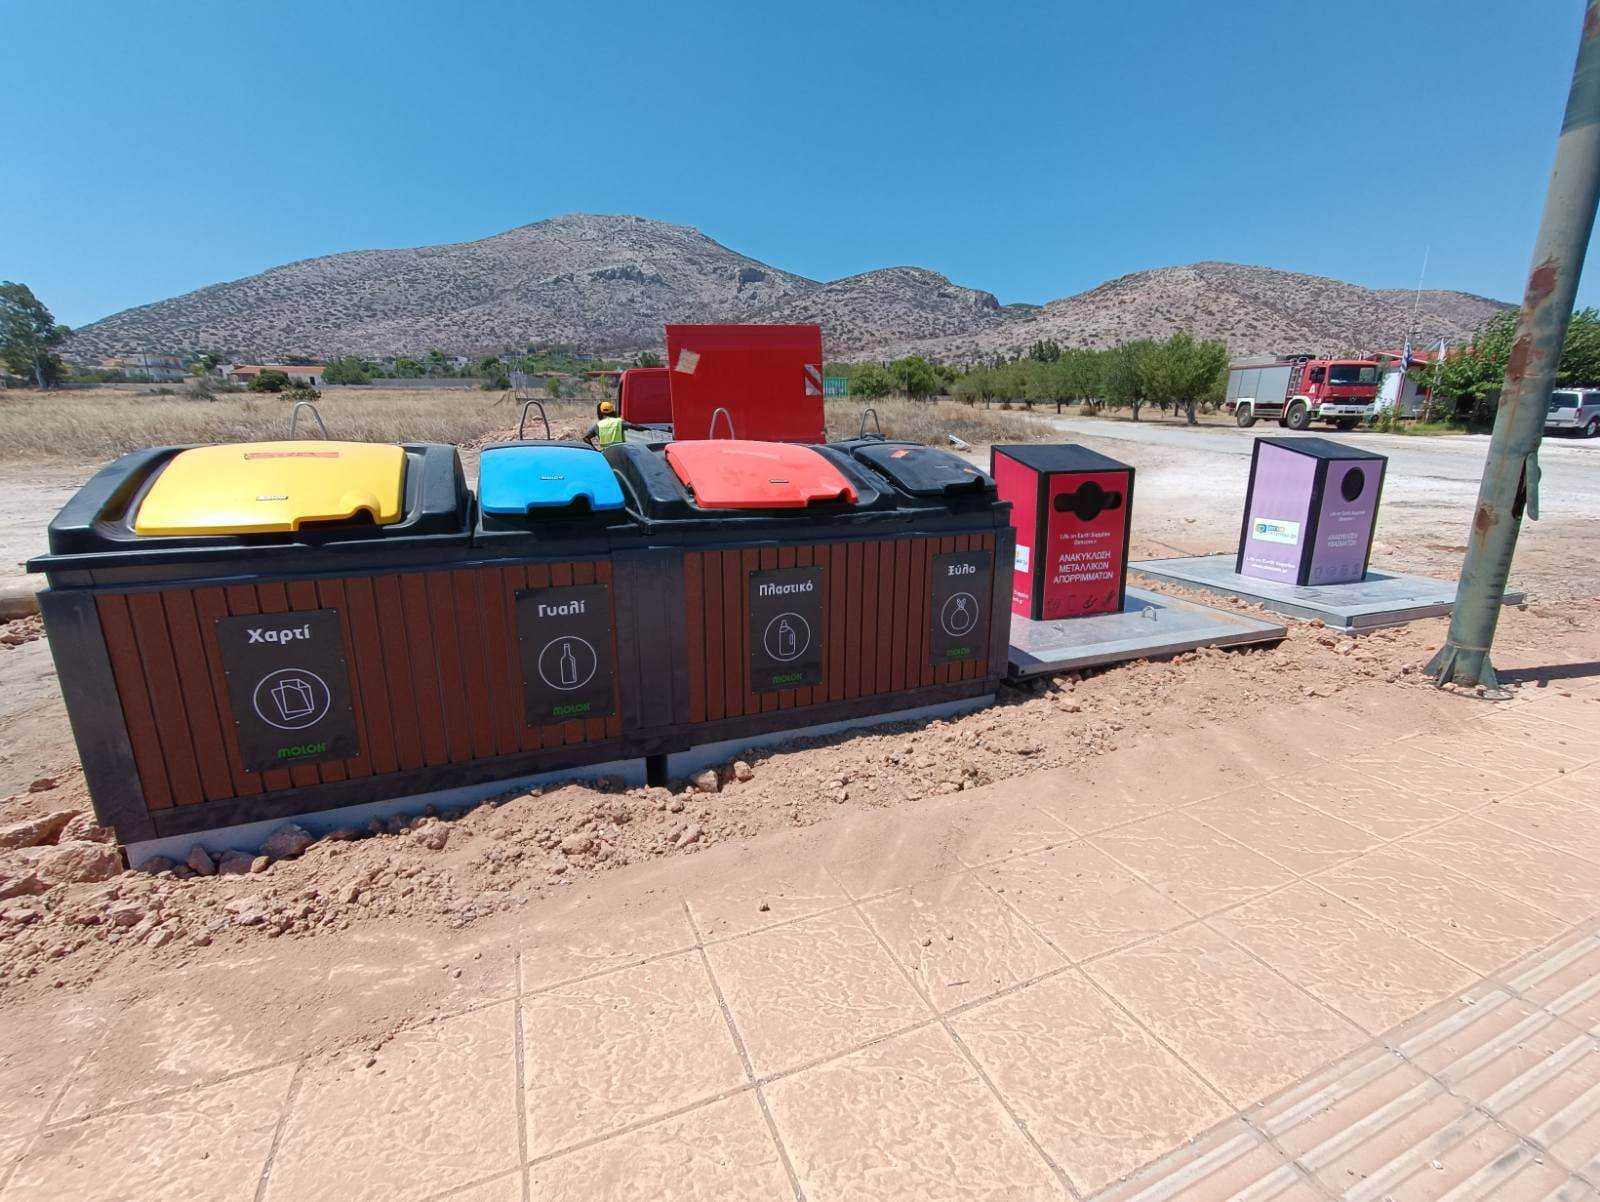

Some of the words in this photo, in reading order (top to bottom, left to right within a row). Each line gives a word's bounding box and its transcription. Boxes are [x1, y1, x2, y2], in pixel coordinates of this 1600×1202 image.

[1059, 550, 1111, 563] ΑΝΑΚΥΚΛΩΣΗ
[947, 564, 976, 576] Ξύλο
[1058, 561, 1109, 573] ΜΕΤΑΛΛΙΚΩΝ
[1053, 571, 1114, 585] ΑΠΟΡΡΙΜΜΑΤΩΝ
[759, 579, 813, 597] Πλαστικό
[538, 600, 586, 618] Γυαλί
[247, 623, 310, 645] Χαρτί
